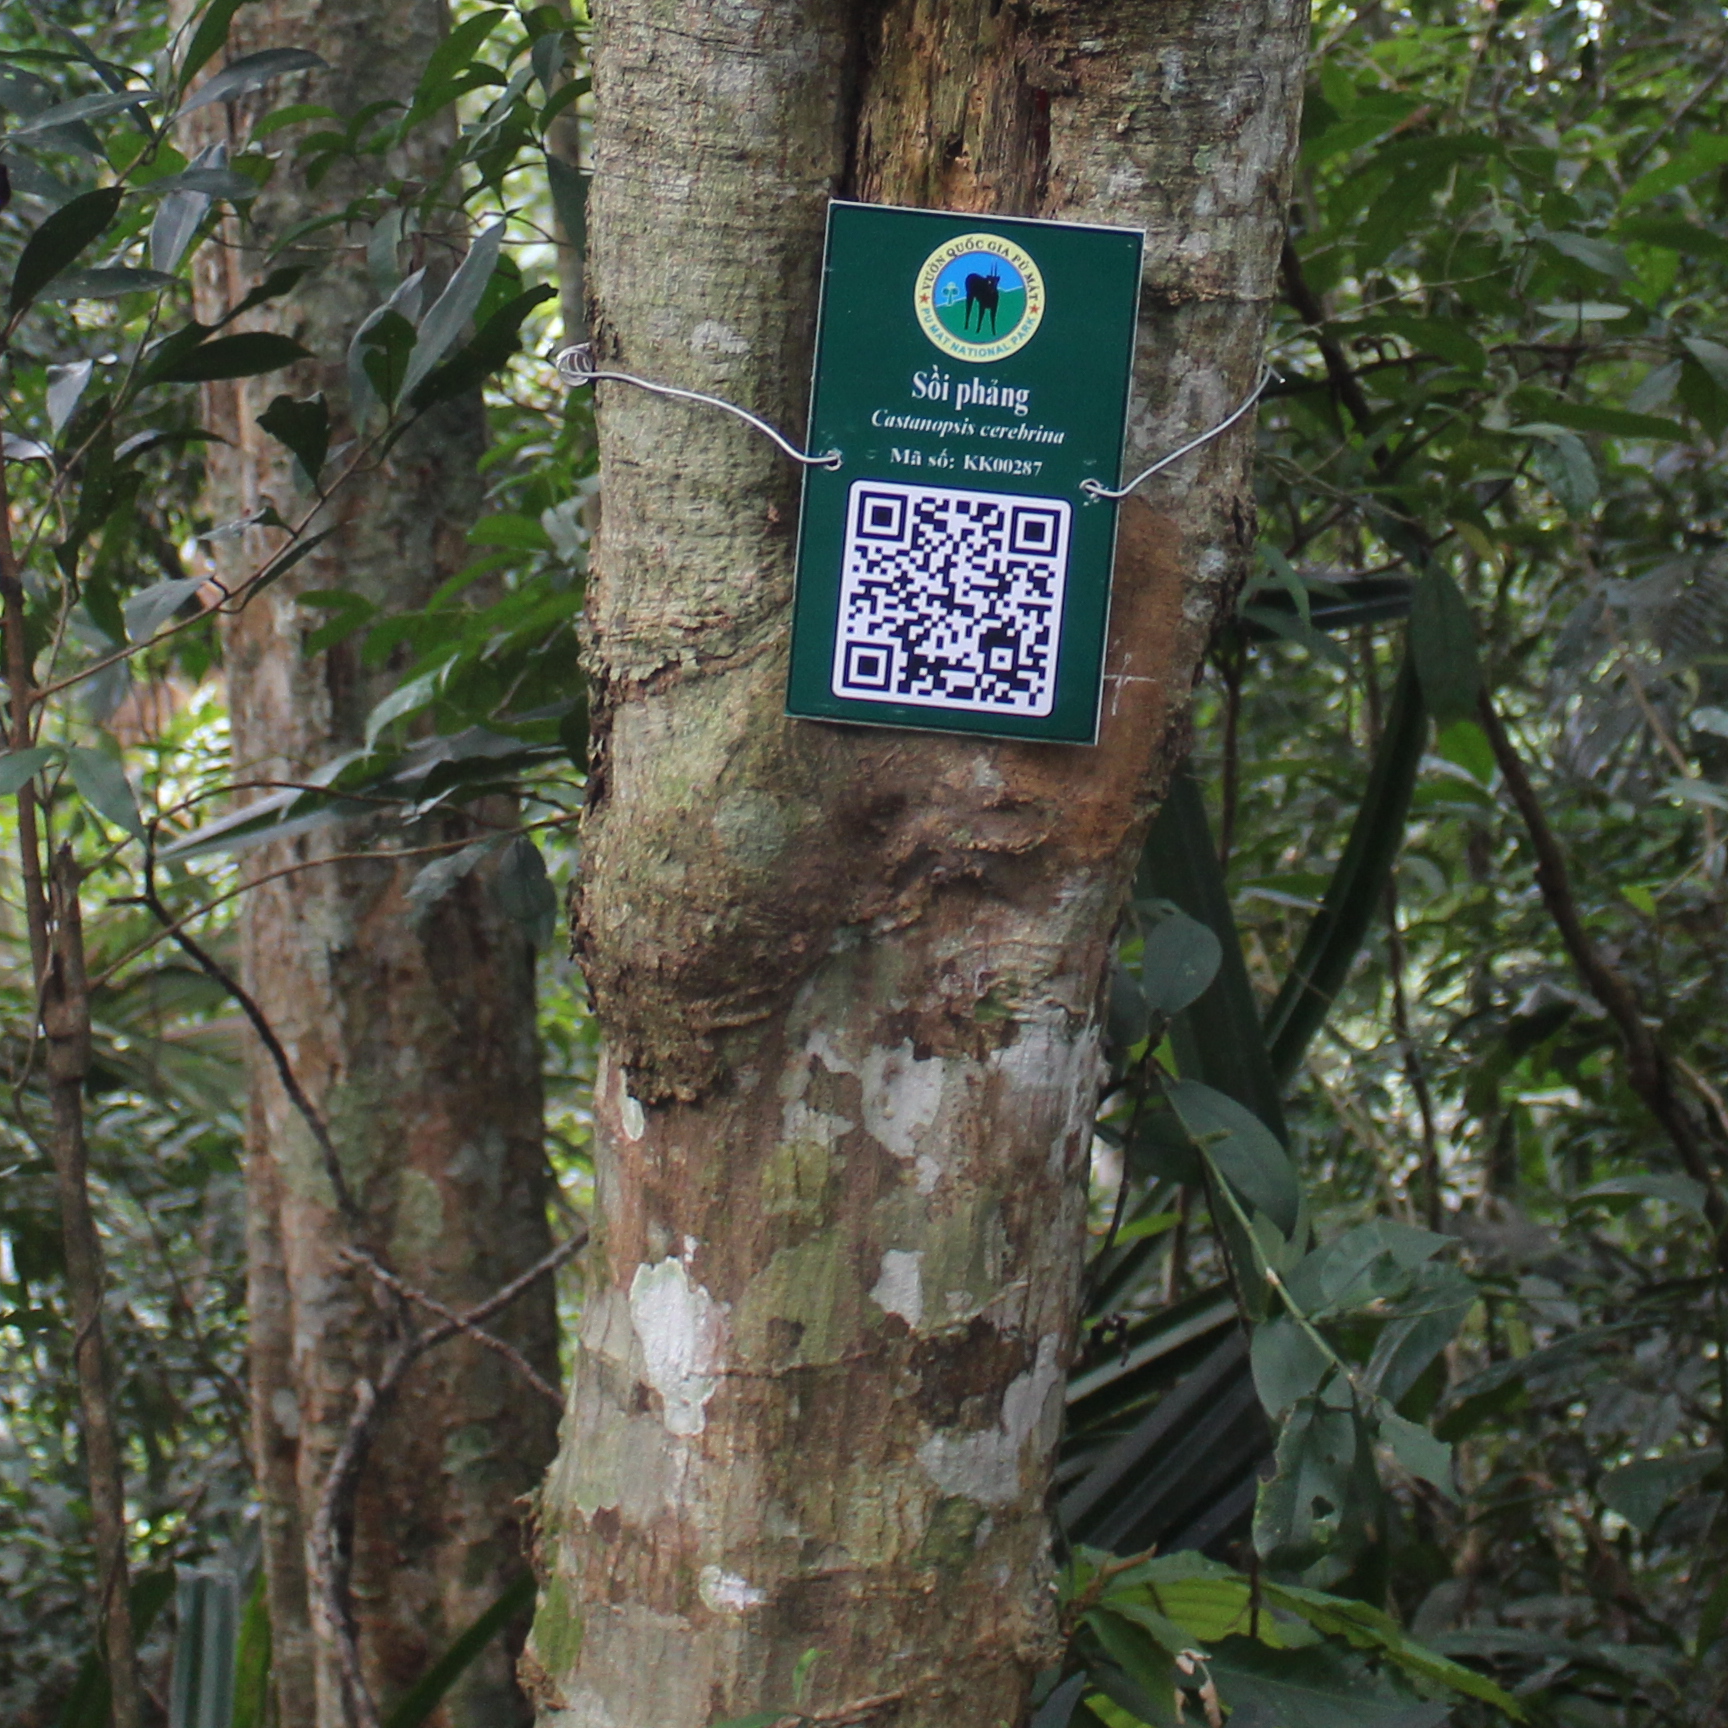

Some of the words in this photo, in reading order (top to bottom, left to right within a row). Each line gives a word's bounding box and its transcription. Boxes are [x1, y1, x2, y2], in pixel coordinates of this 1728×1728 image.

[946, 237, 985, 259] QUỐC
[987, 241, 1010, 257] GIA
[921, 307, 934, 323] PU
[929, 321, 951, 345] MAT
[950, 342, 1011, 358] NATIONAL
[1010, 317, 1036, 344] PARK
[911, 364, 950, 402] Sồi
[955, 376, 1031, 417] phảng
[871, 408, 976, 438] Castanopsis
[979, 423, 1065, 445] cerebrina
[890, 447, 922, 467] Mã
[927, 448, 956, 470] số:
[963, 454, 1043, 477] KK00287
